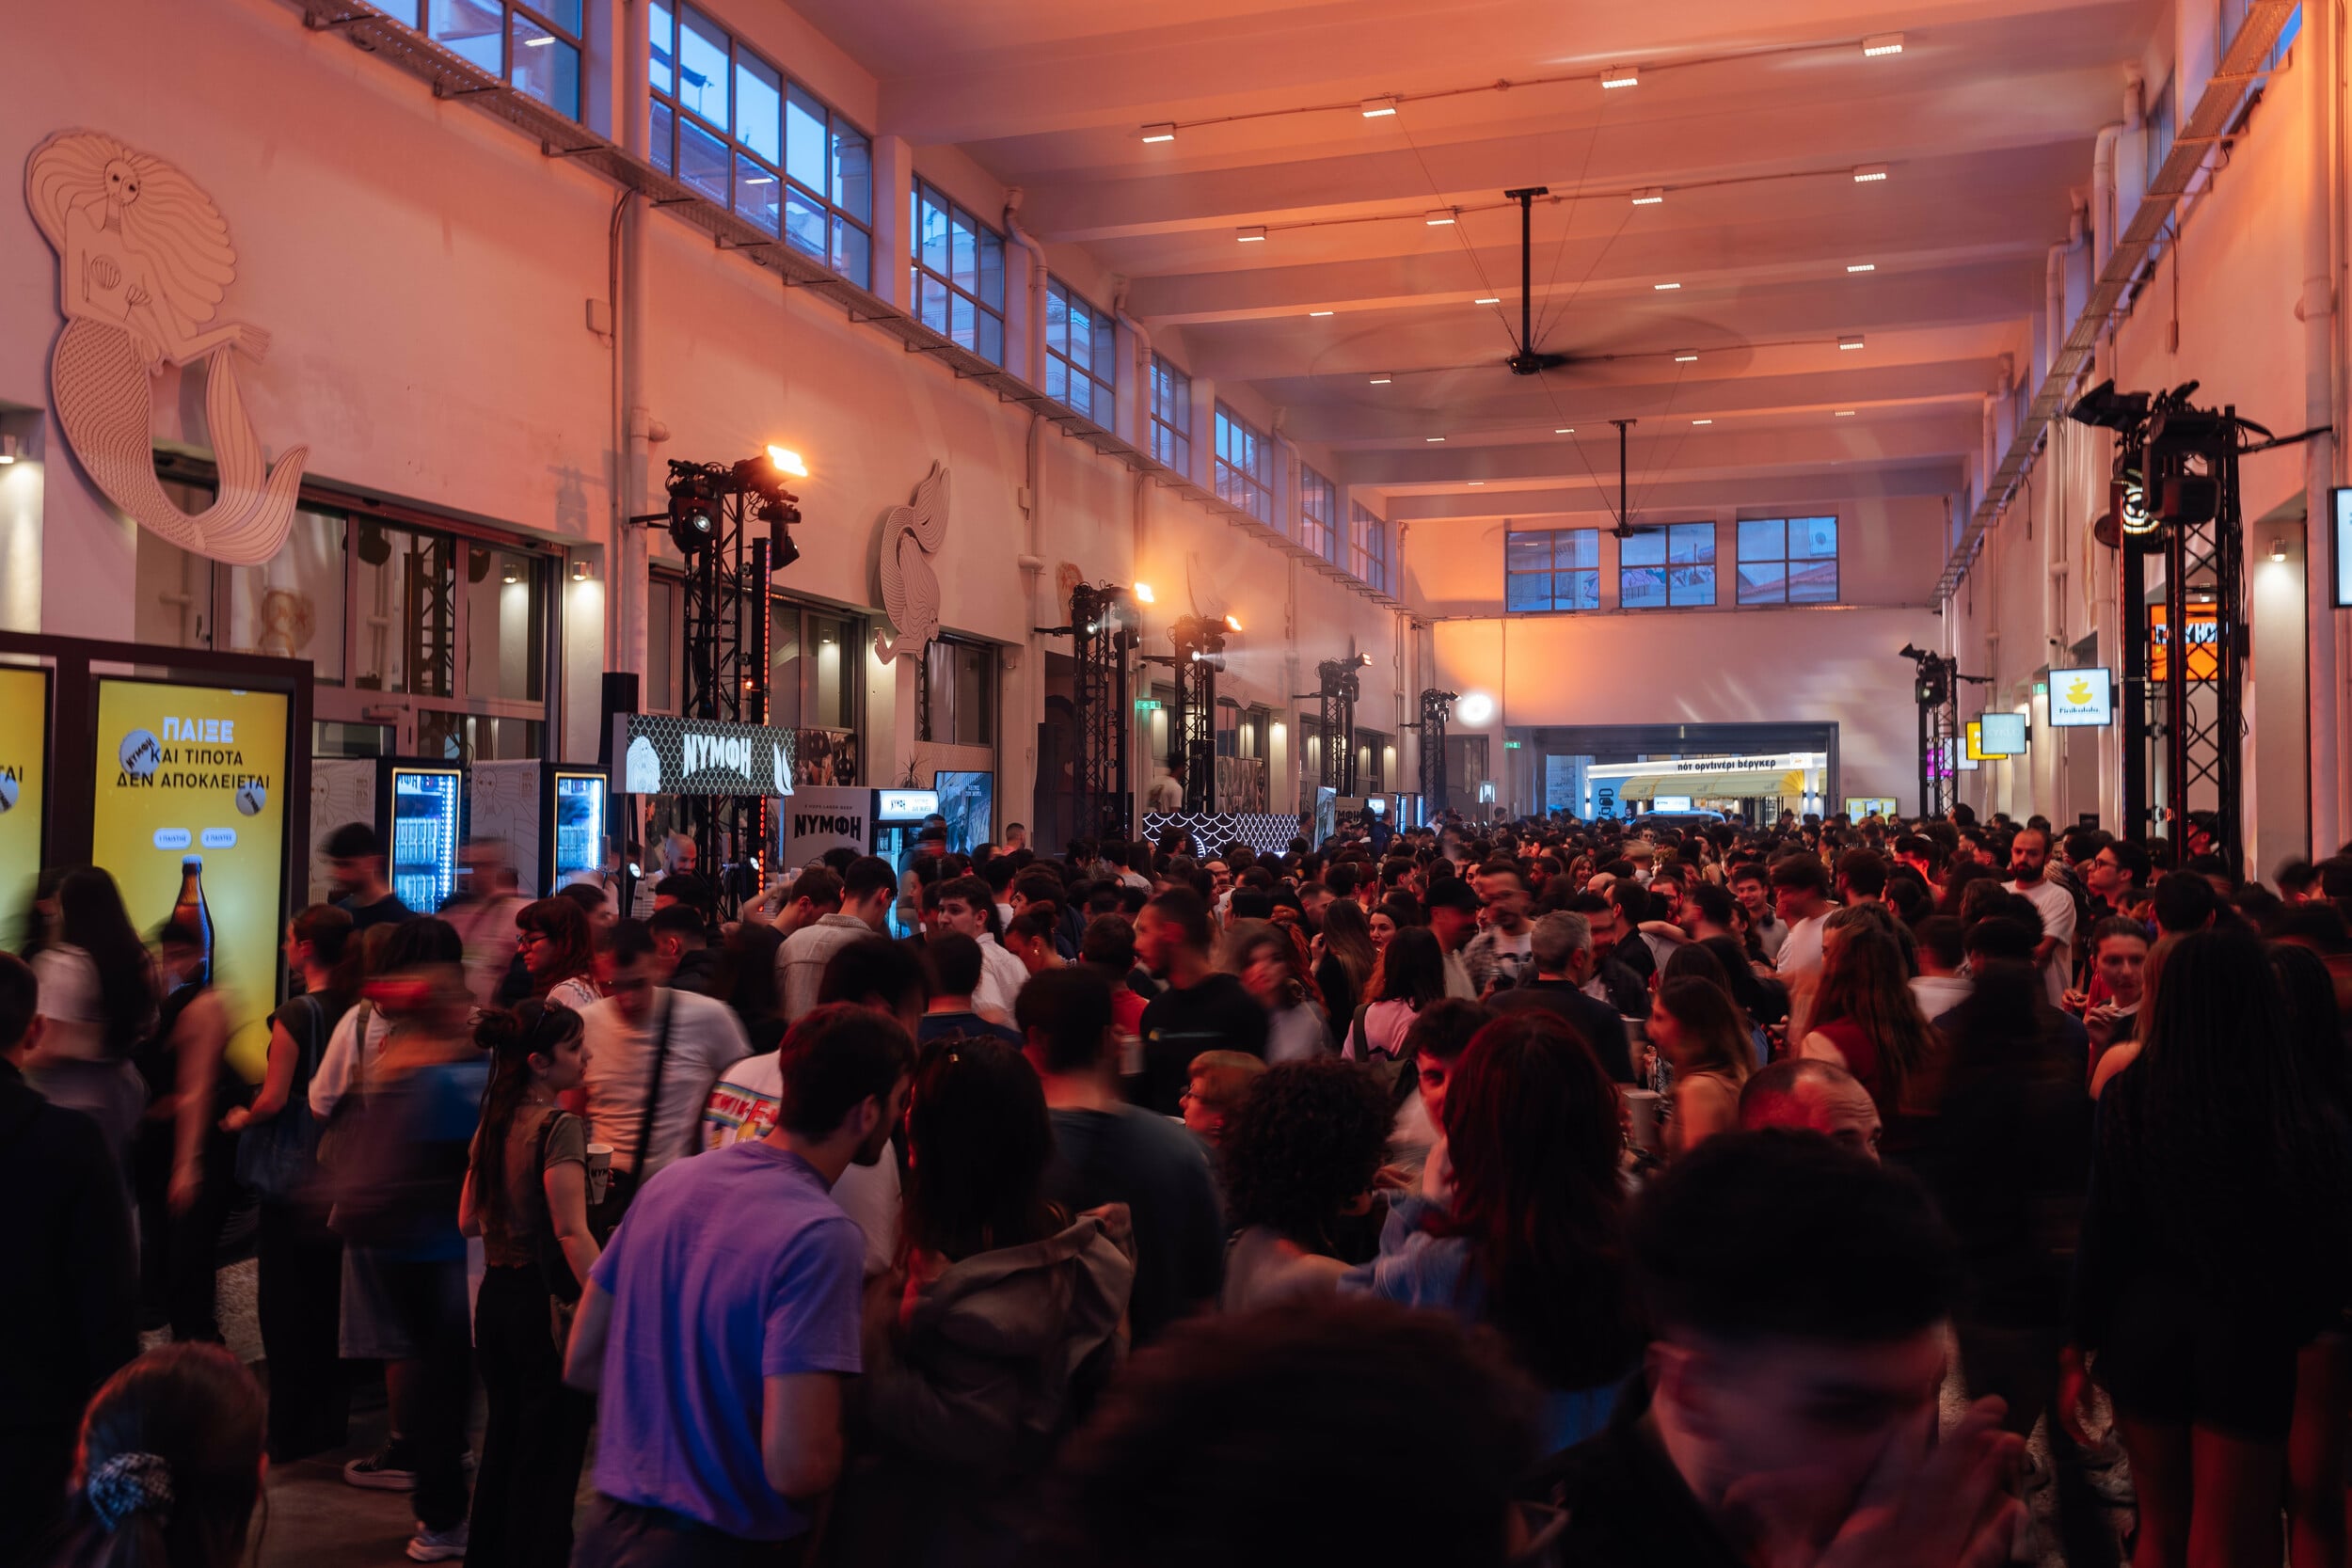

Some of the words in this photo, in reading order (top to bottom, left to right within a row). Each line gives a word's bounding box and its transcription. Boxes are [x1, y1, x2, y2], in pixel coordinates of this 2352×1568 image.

[163, 717, 234, 743] ΠΑΙΞΕ
[151, 748, 179, 764] ΚΑΙ
[184, 749, 244, 766] ΤΙΠΟΤΑ
[683, 733, 752, 780] ΝΥΜΦΗ
[117, 772, 154, 788] ΔΕΝ
[161, 772, 270, 790] ΑΠΟΚΛΕΙΕΤΑΙ
[794, 814, 862, 842] ΝΥΜΦΗ
